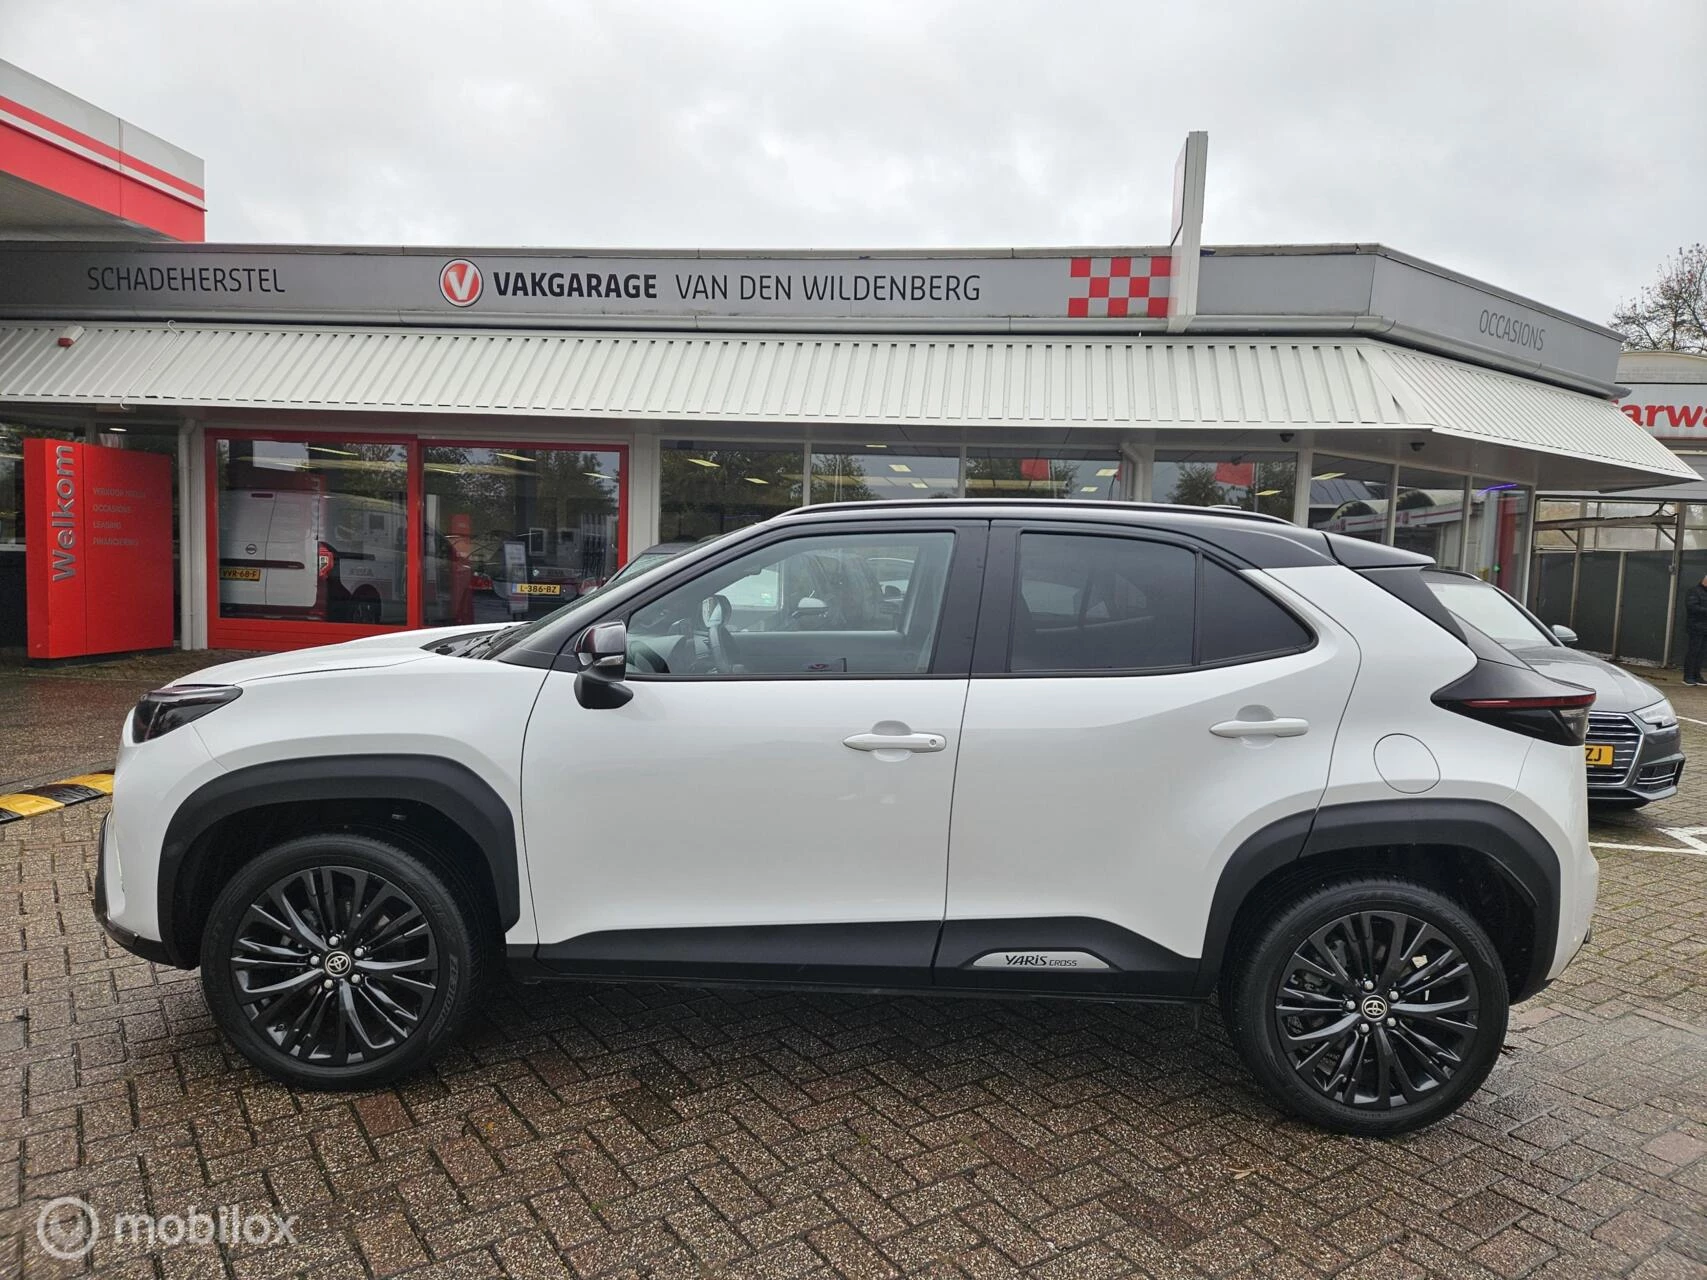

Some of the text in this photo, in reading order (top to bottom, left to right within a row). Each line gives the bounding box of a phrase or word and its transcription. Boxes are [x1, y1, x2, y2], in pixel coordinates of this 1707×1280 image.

[87, 266, 286, 293] SCHADEHERSTEL
[492, 271, 658, 299] VAKGARAGE
[675, 274, 728, 300] VAN
[740, 275, 792, 300] DEN
[802, 274, 981, 301] WILDENBERG
[1479, 309, 1546, 351] OCCASIONS
[51, 445, 76, 582] Welkom
[520, 584, 557, 593] L-386-BZ
[1049, 959, 1077, 967] CROSS
